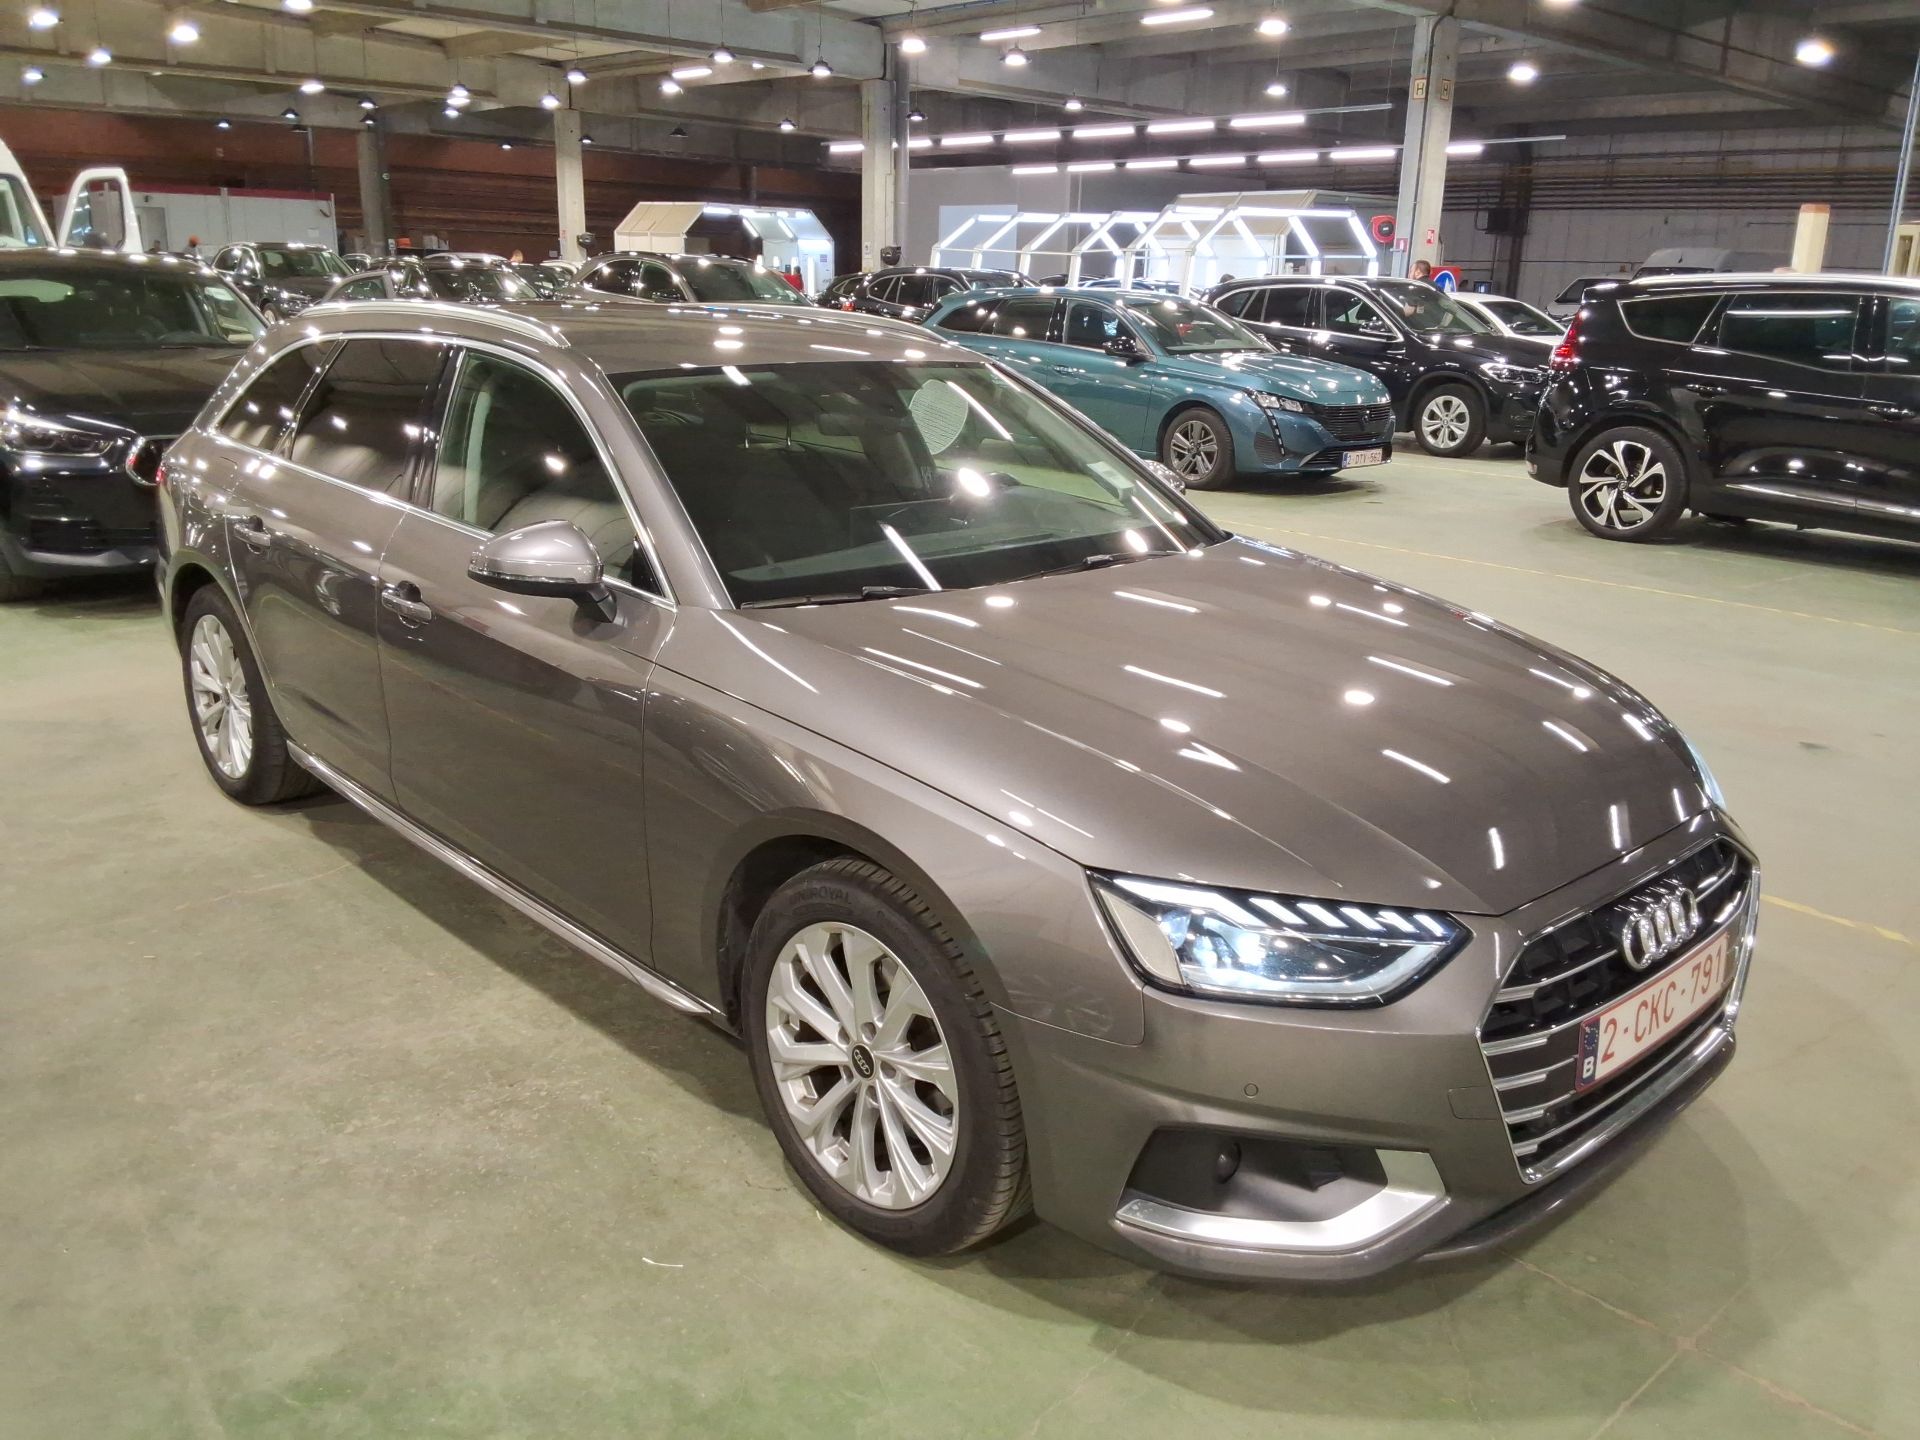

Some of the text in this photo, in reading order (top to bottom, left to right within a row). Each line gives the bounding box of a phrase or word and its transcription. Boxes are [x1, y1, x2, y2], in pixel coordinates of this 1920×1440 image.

[1416, 82, 1425, 95] H
[1600, 943, 1724, 1064] 2-CKC-791
[1582, 1056, 1595, 1079] B
